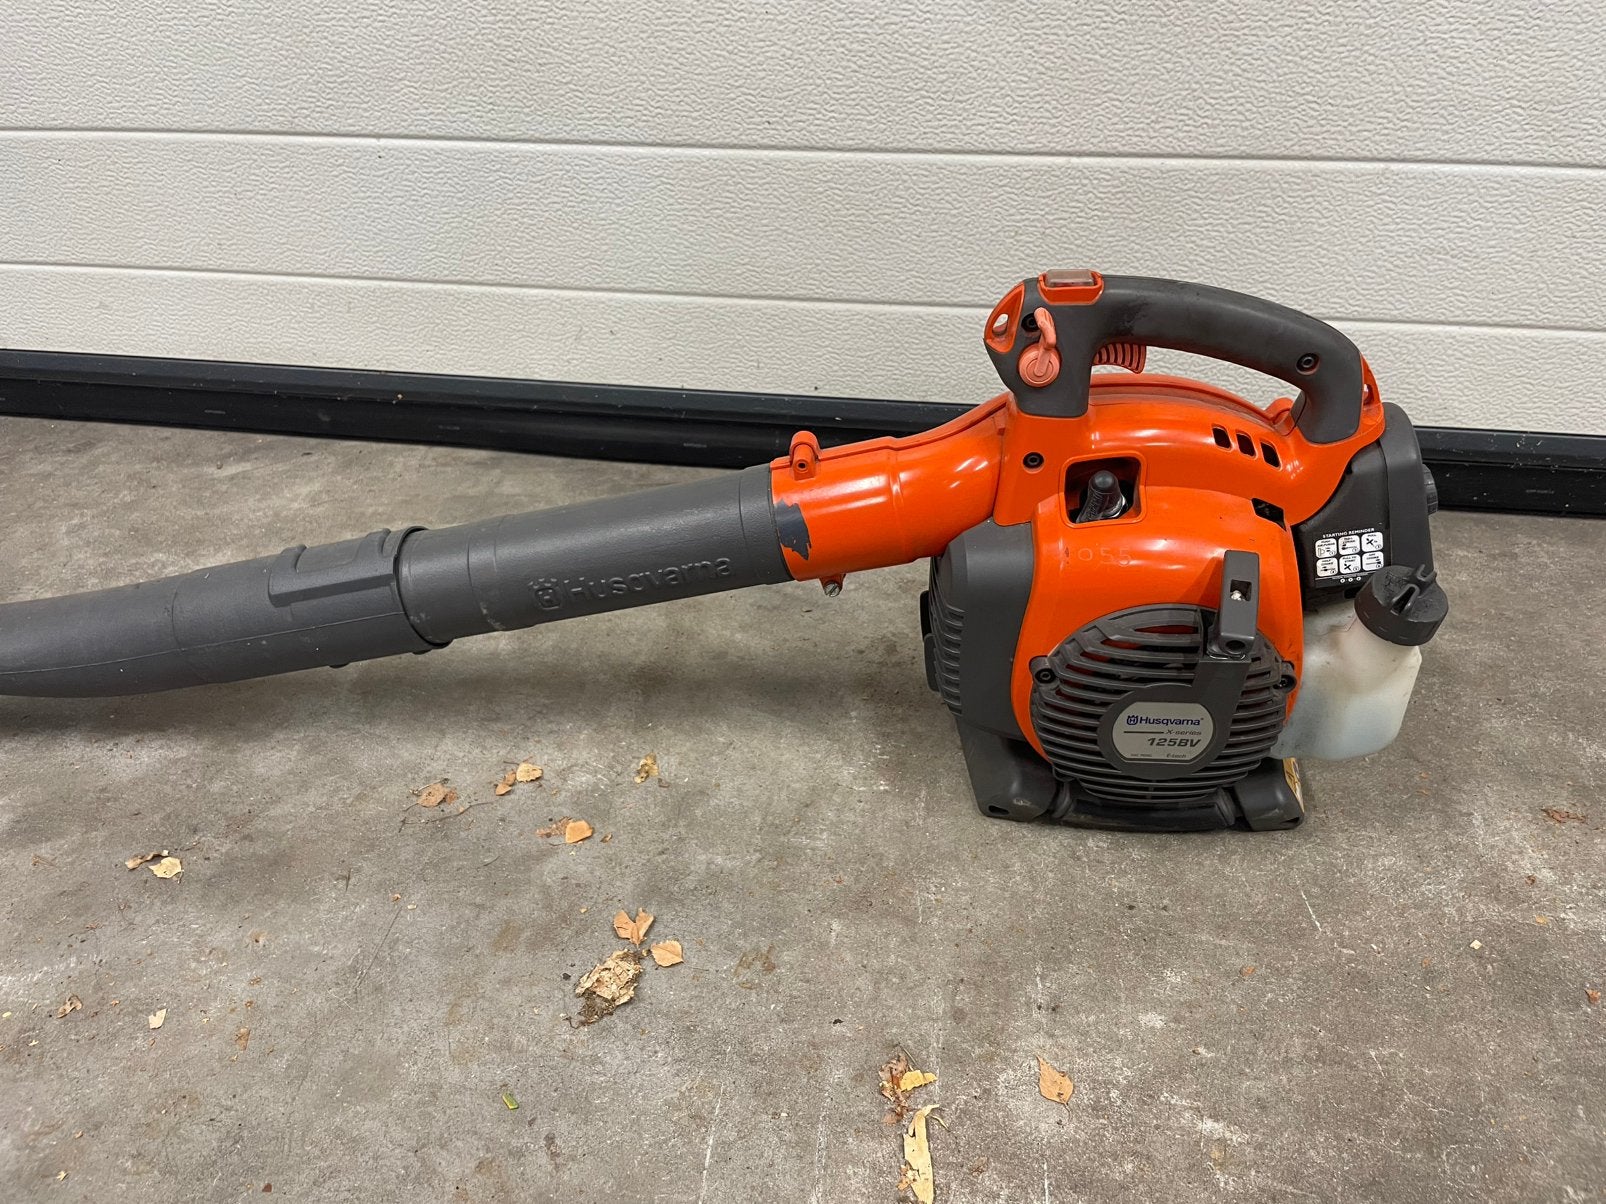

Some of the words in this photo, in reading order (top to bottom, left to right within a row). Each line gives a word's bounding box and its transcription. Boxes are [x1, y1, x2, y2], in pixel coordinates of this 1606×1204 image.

[1322, 531, 1348, 539] STARTING
[1348, 527, 1375, 535] REMINDER
[563, 557, 731, 600] Husqvarna
[1139, 716, 1200, 726] Husqvarna
[1147, 737, 1202, 748] 125BV
